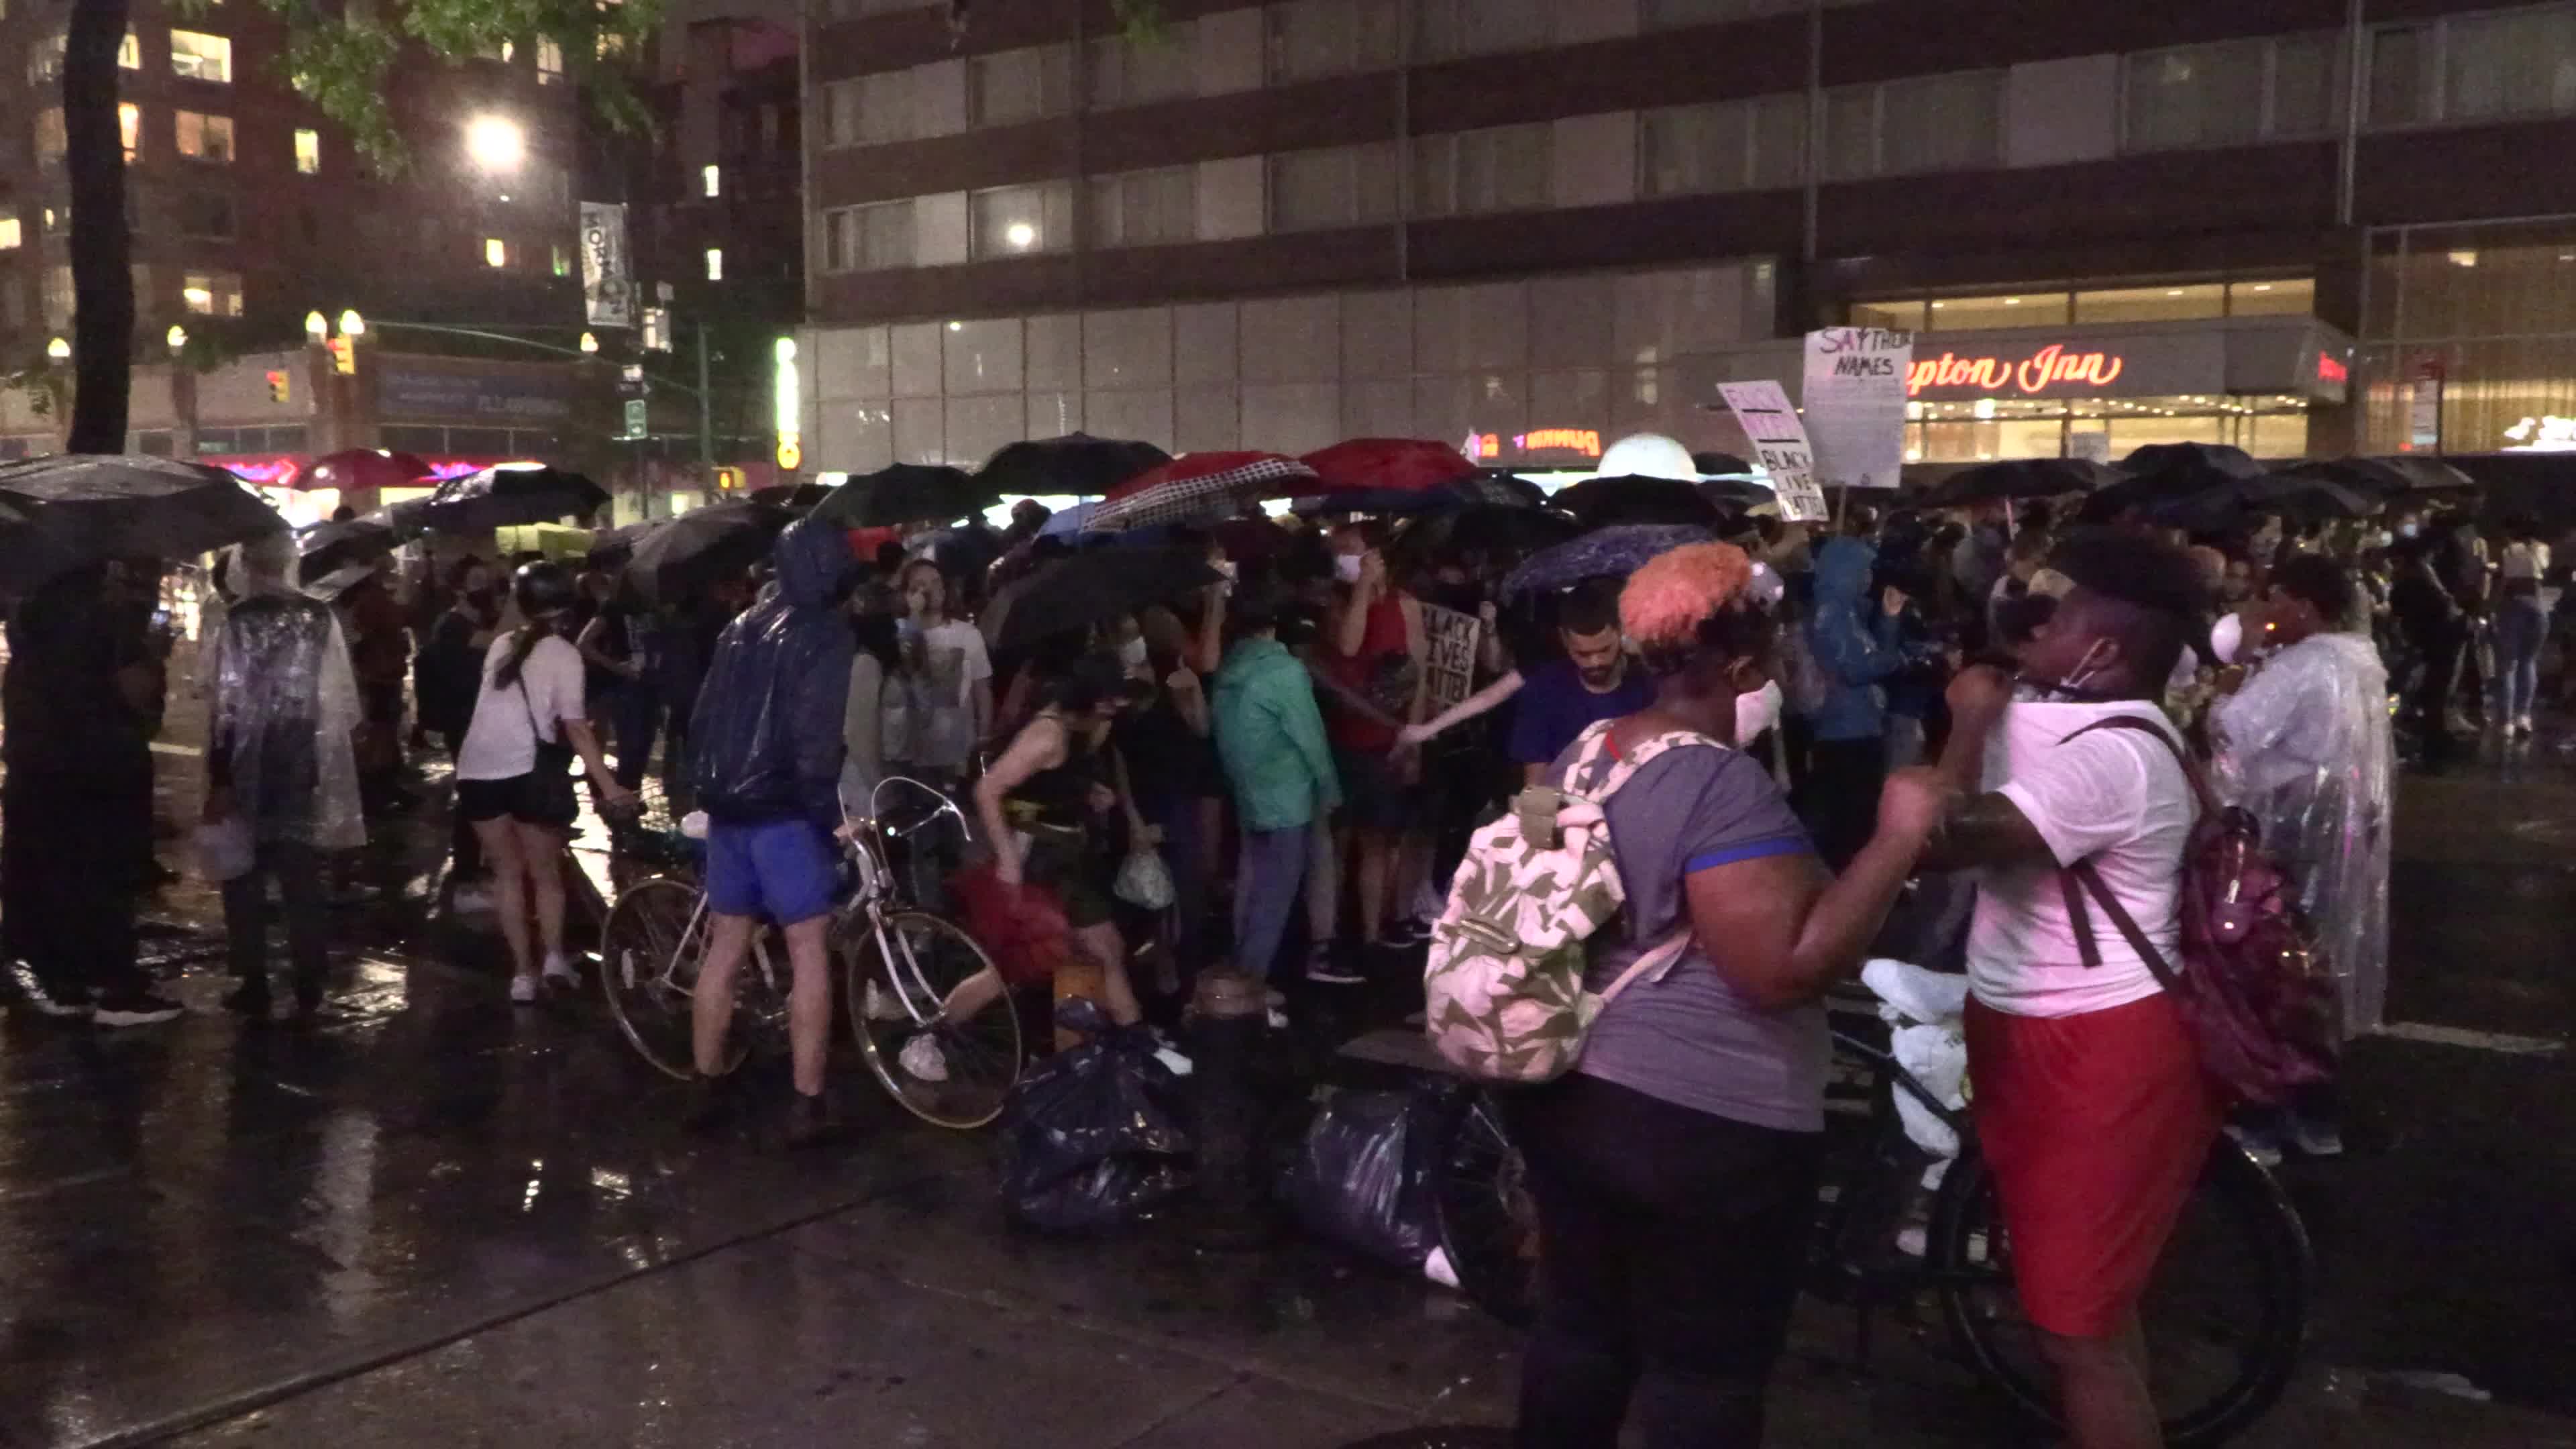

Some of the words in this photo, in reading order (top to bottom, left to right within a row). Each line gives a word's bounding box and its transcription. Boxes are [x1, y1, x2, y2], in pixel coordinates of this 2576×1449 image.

[1820, 324, 1870, 353] SAY
[1833, 356, 1894, 376] NAMES
[1906, 352, 2012, 396] pton
[2018, 343, 2122, 393] Inn
[1427, 638, 1469, 673] IVES
